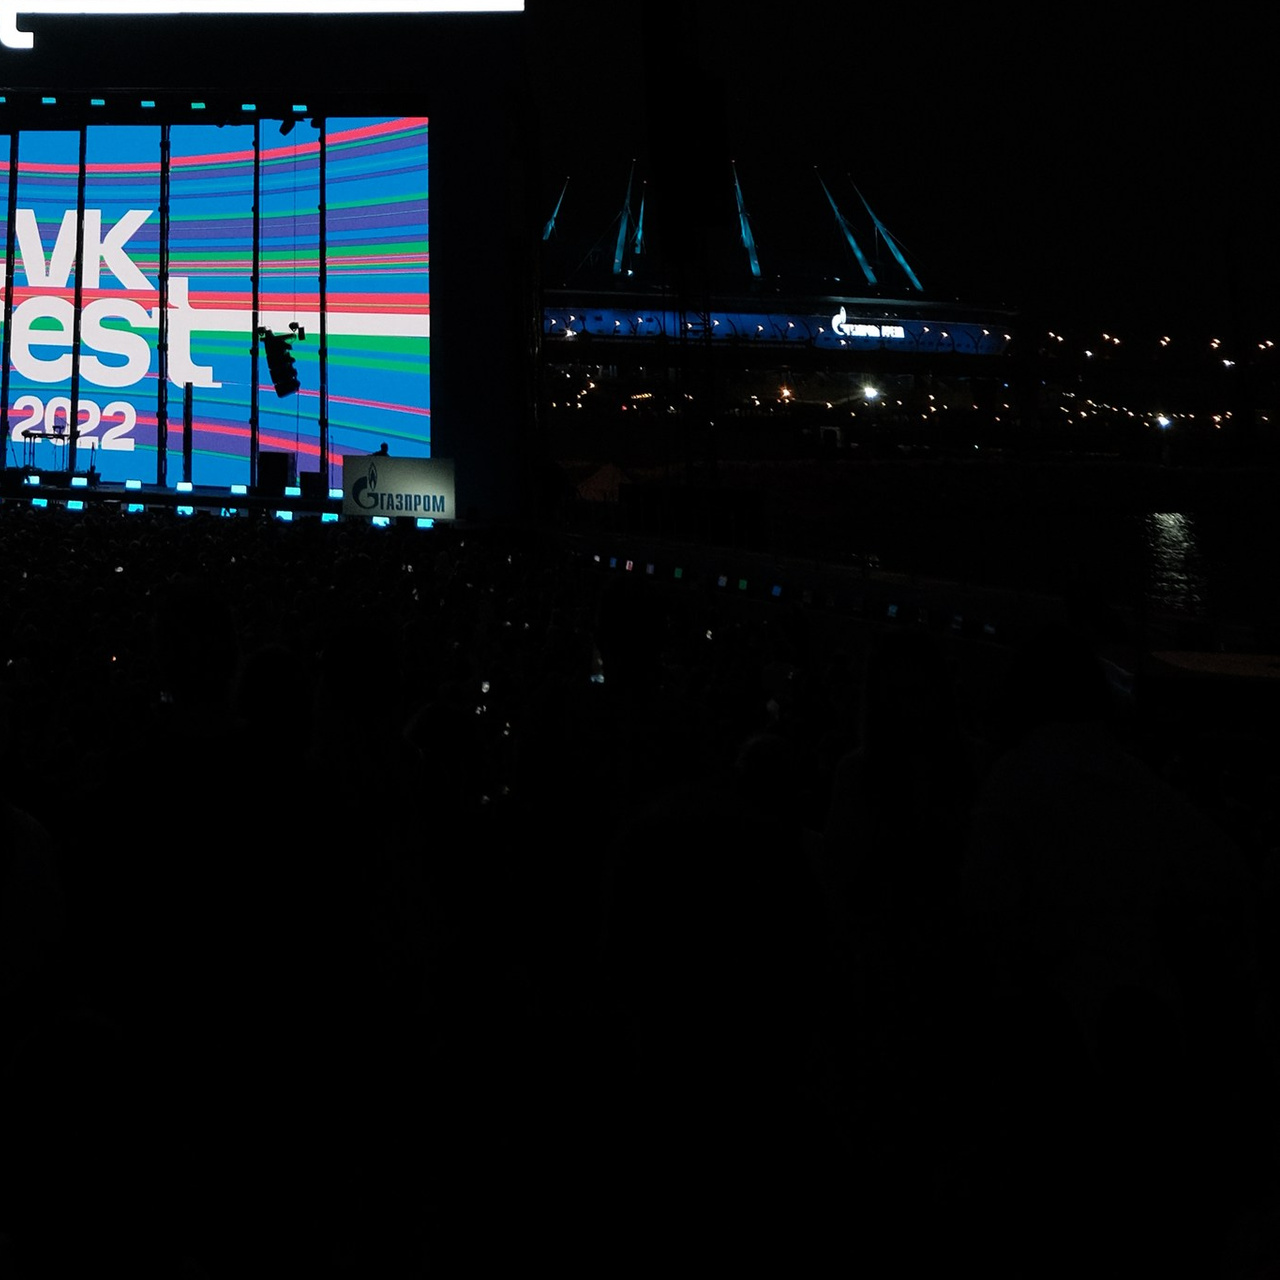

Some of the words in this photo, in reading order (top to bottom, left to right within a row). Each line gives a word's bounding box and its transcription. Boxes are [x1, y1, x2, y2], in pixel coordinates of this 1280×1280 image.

[15, 209, 156, 290] VK
[11, 395, 137, 452] 2022
[379, 492, 446, 513] ГАЗПРОМ
